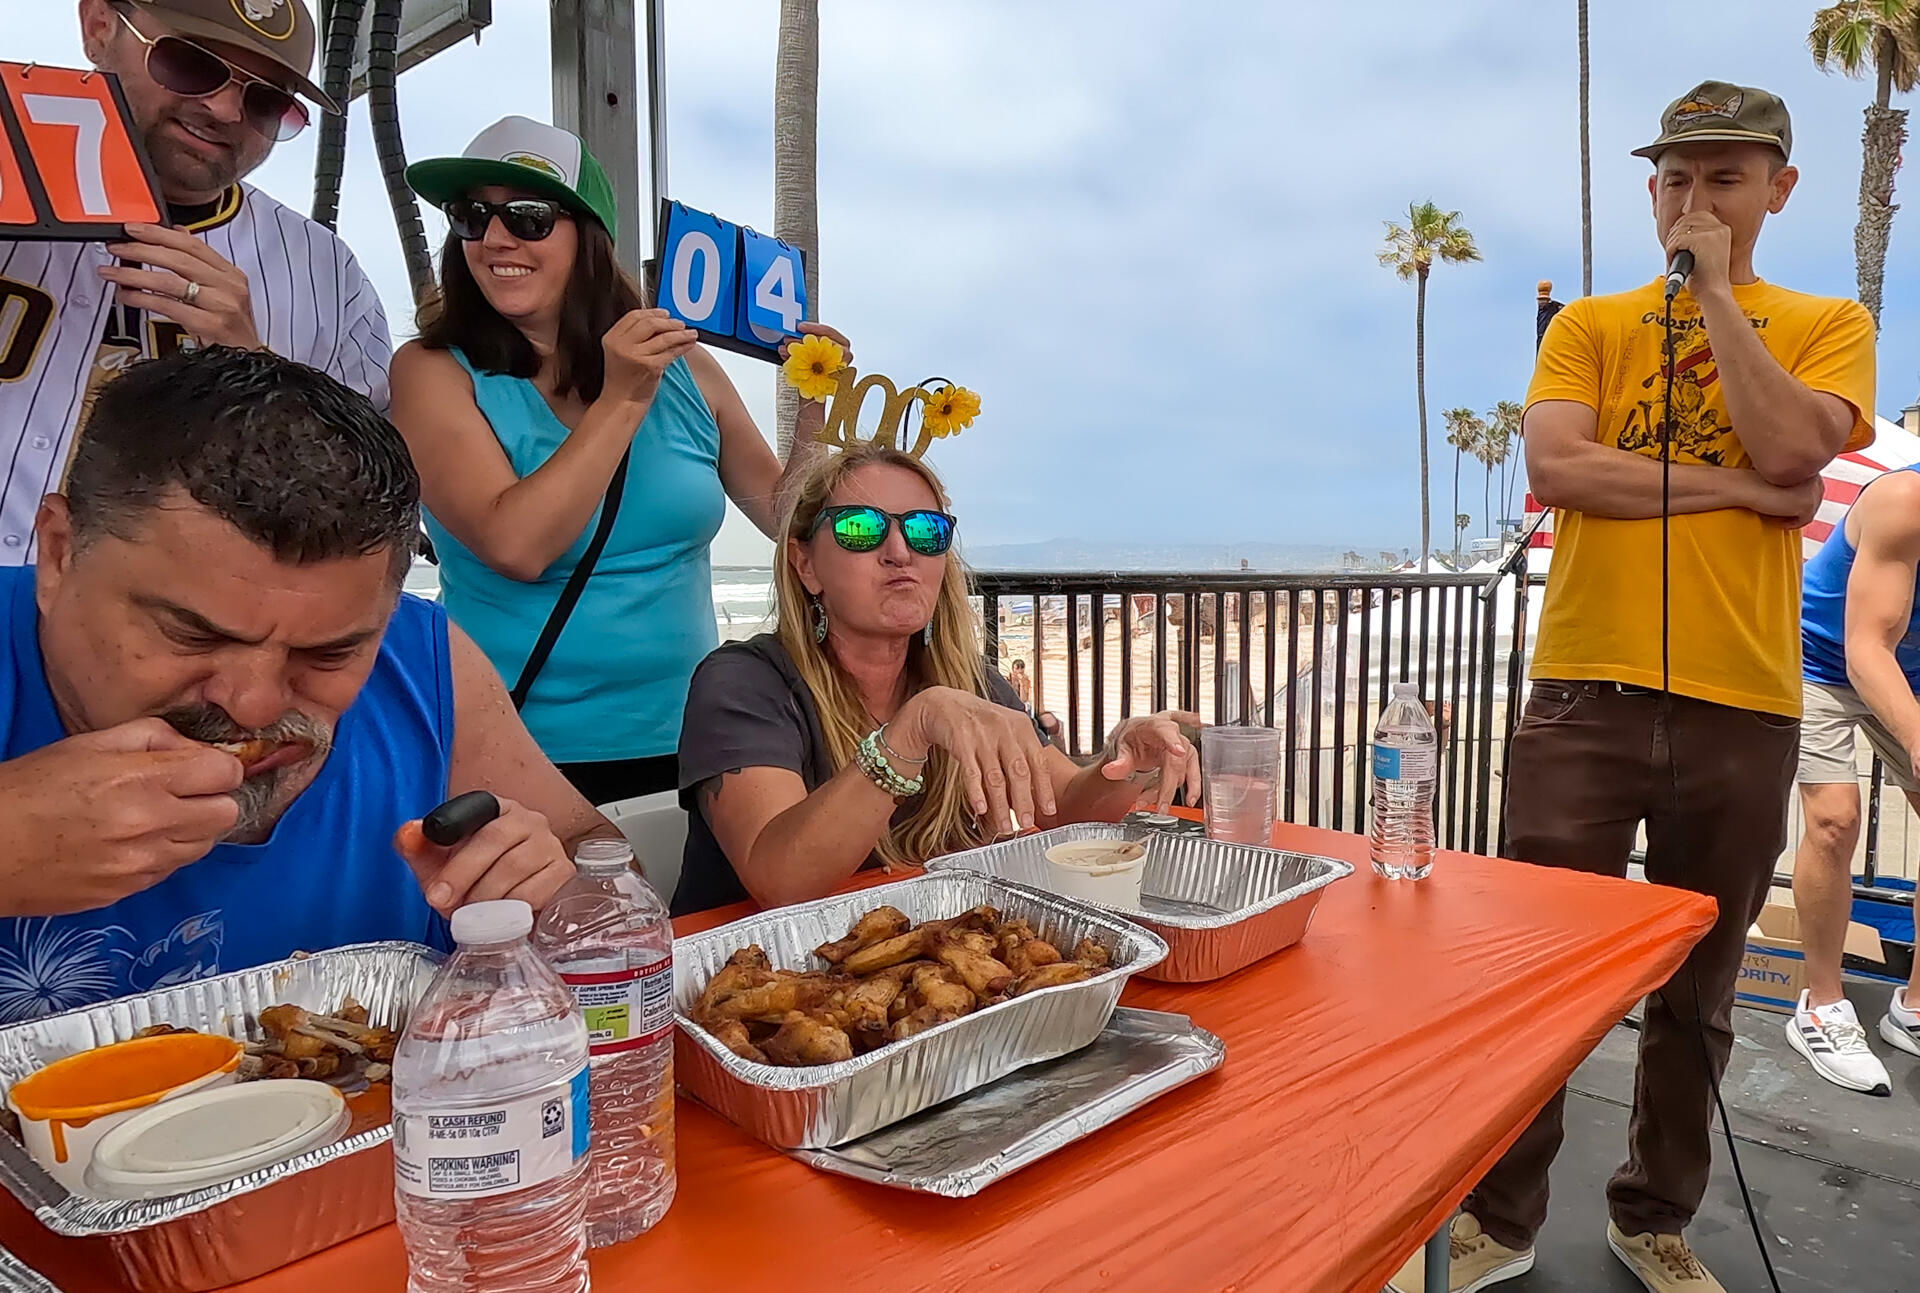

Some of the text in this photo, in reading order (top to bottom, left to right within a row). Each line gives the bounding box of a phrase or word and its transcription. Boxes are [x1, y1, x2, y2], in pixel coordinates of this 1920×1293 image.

[22, 93, 112, 216] 7
[1738, 967, 1791, 985] ORITY
[442, 1116, 466, 1127] CASH
[467, 1112, 503, 1126] REFUND
[458, 1128, 468, 1139] OR
[431, 1158, 470, 1171] CHOKING
[472, 1152, 516, 1170] WARNING
